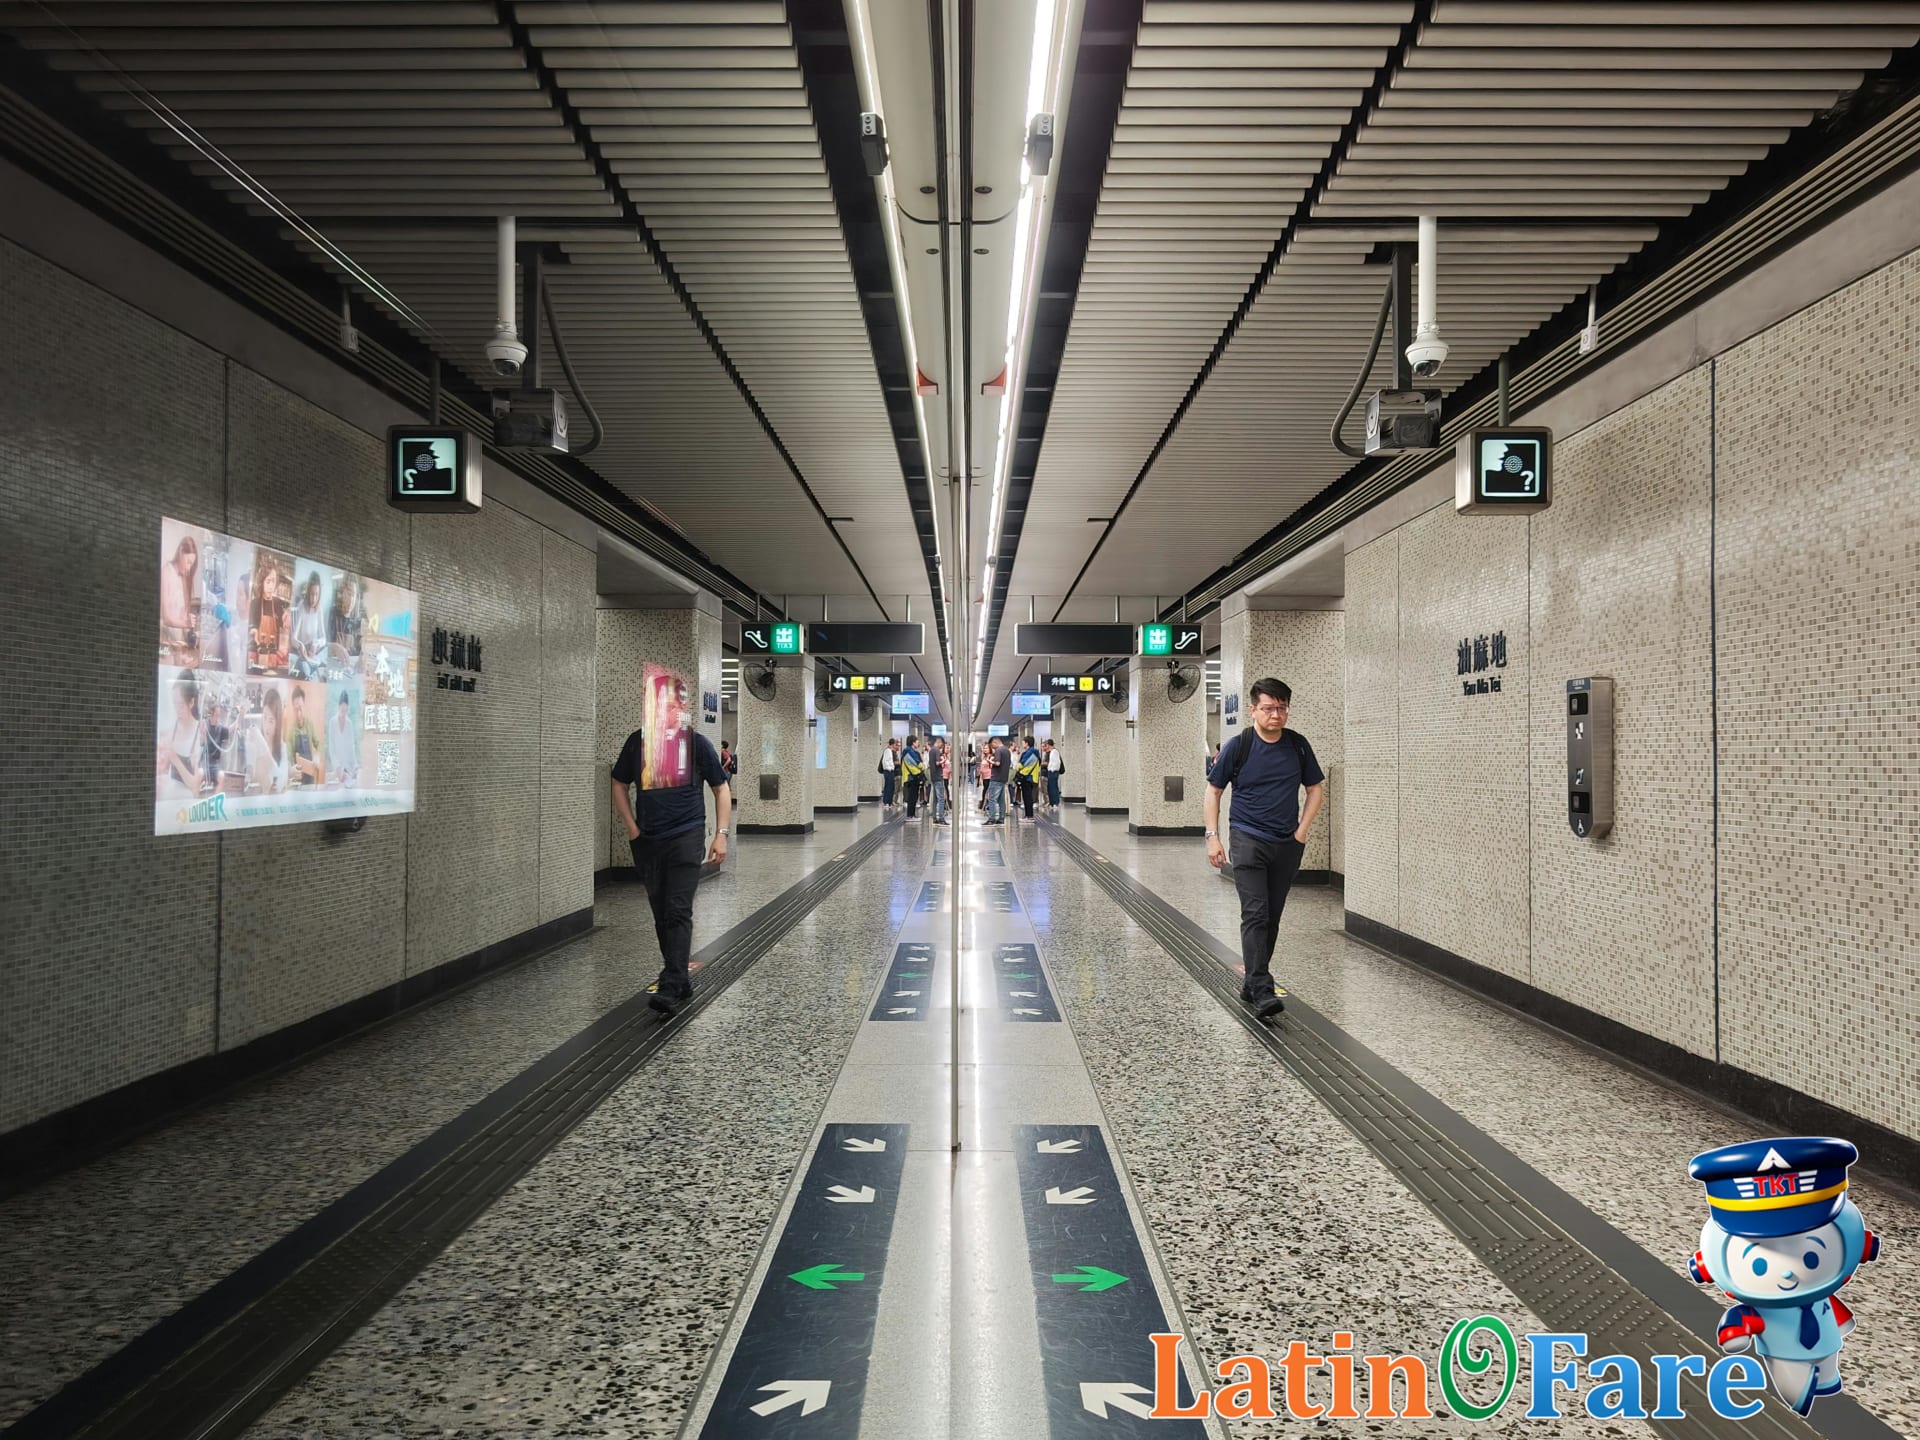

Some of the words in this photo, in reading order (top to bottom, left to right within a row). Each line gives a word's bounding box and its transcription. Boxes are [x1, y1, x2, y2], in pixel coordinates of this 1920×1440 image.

[1149, 629, 1167, 645] 出
[1457, 630, 1507, 675] 油麻地
[1463, 680, 1476, 696] Yau
[1489, 675, 1502, 693] Tei
[189, 793, 229, 823] LOUDER
